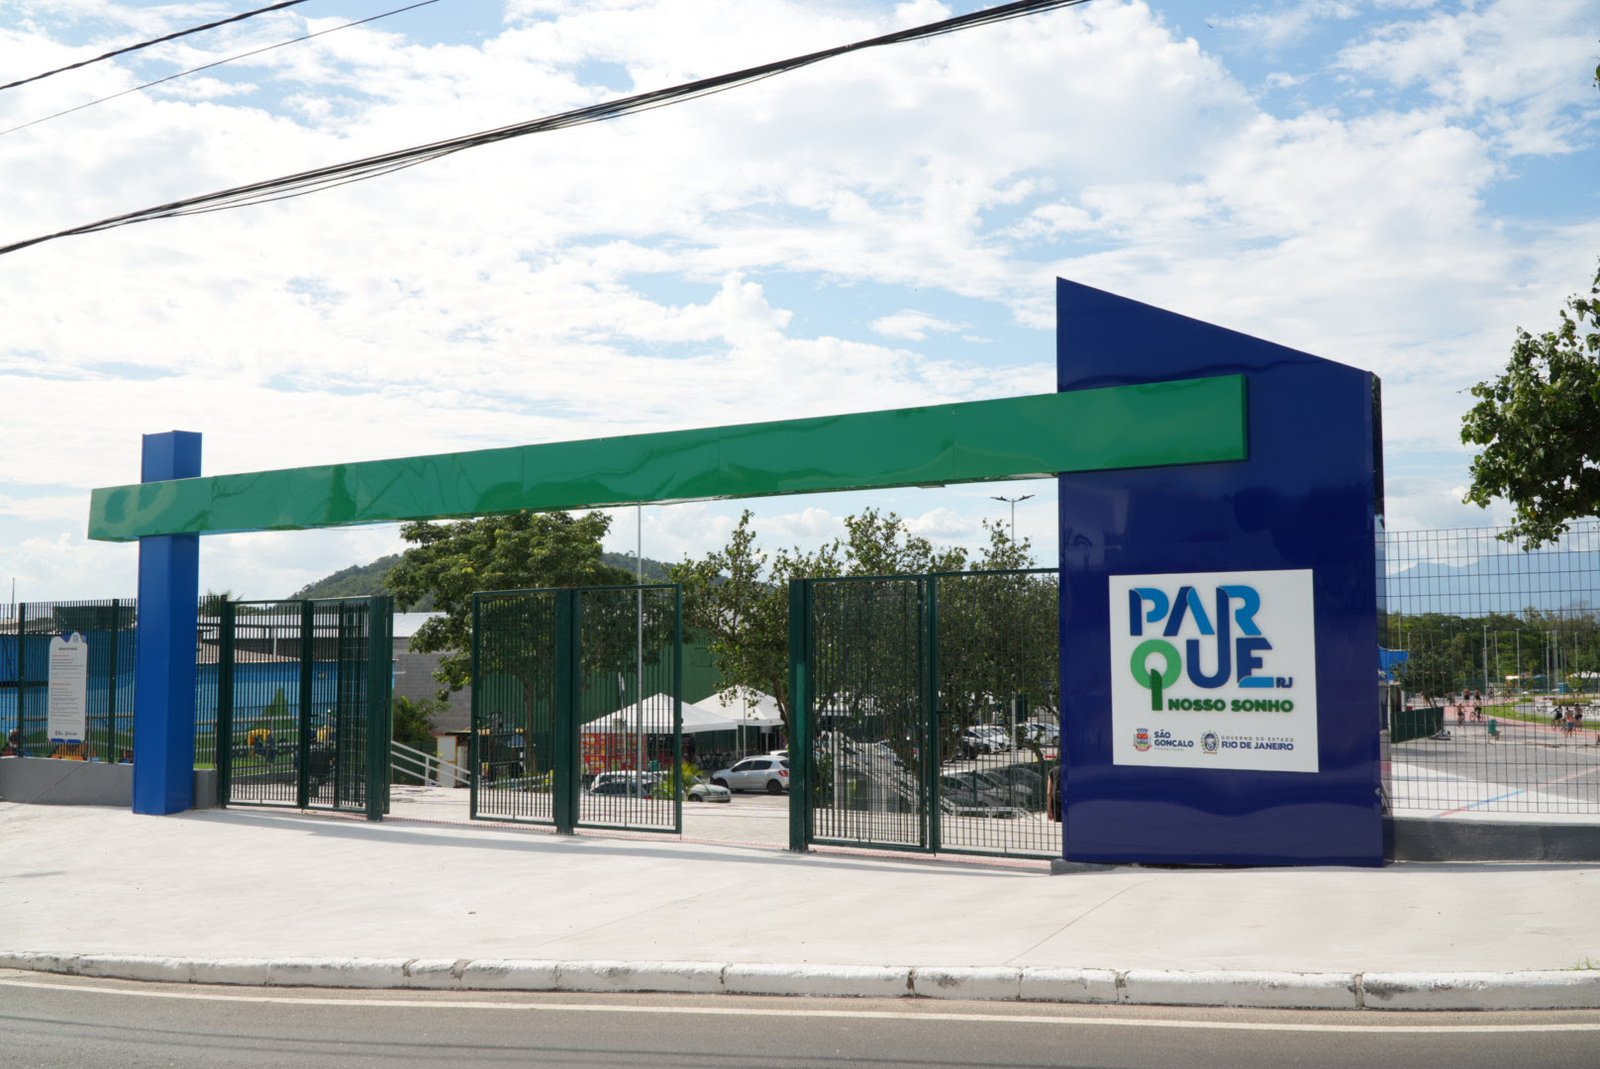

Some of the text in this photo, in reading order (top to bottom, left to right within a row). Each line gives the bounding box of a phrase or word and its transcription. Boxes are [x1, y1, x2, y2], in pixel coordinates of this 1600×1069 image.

[1275, 677, 1293, 688] RJ
[1168, 698, 1294, 713] NOSSO SONHO
[1154, 729, 1171, 739] SÃO
[1221, 741, 1294, 751] RIO DE JANEIRO
